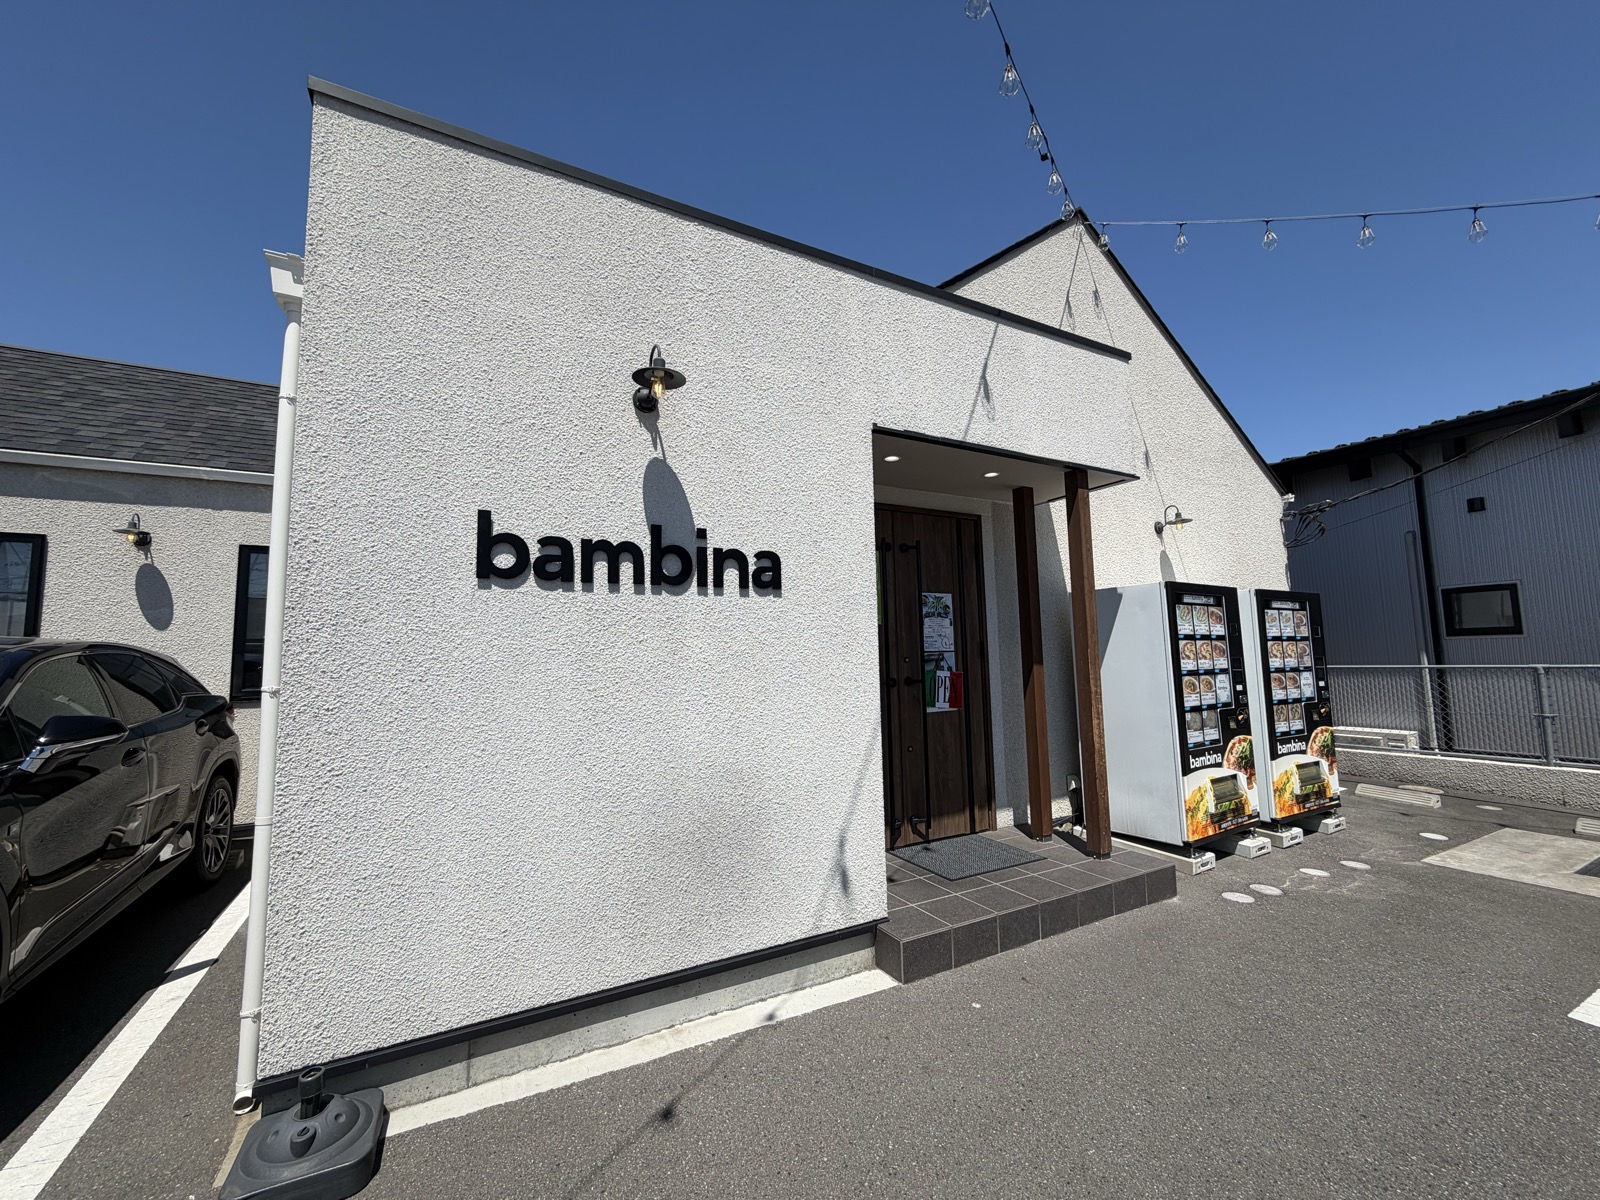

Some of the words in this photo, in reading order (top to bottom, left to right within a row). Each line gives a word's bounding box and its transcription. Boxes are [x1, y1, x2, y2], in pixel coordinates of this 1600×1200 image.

[476, 509, 782, 590] bambina
[1277, 739, 1306, 755] bambina
[1190, 750, 1222, 769] bambina
